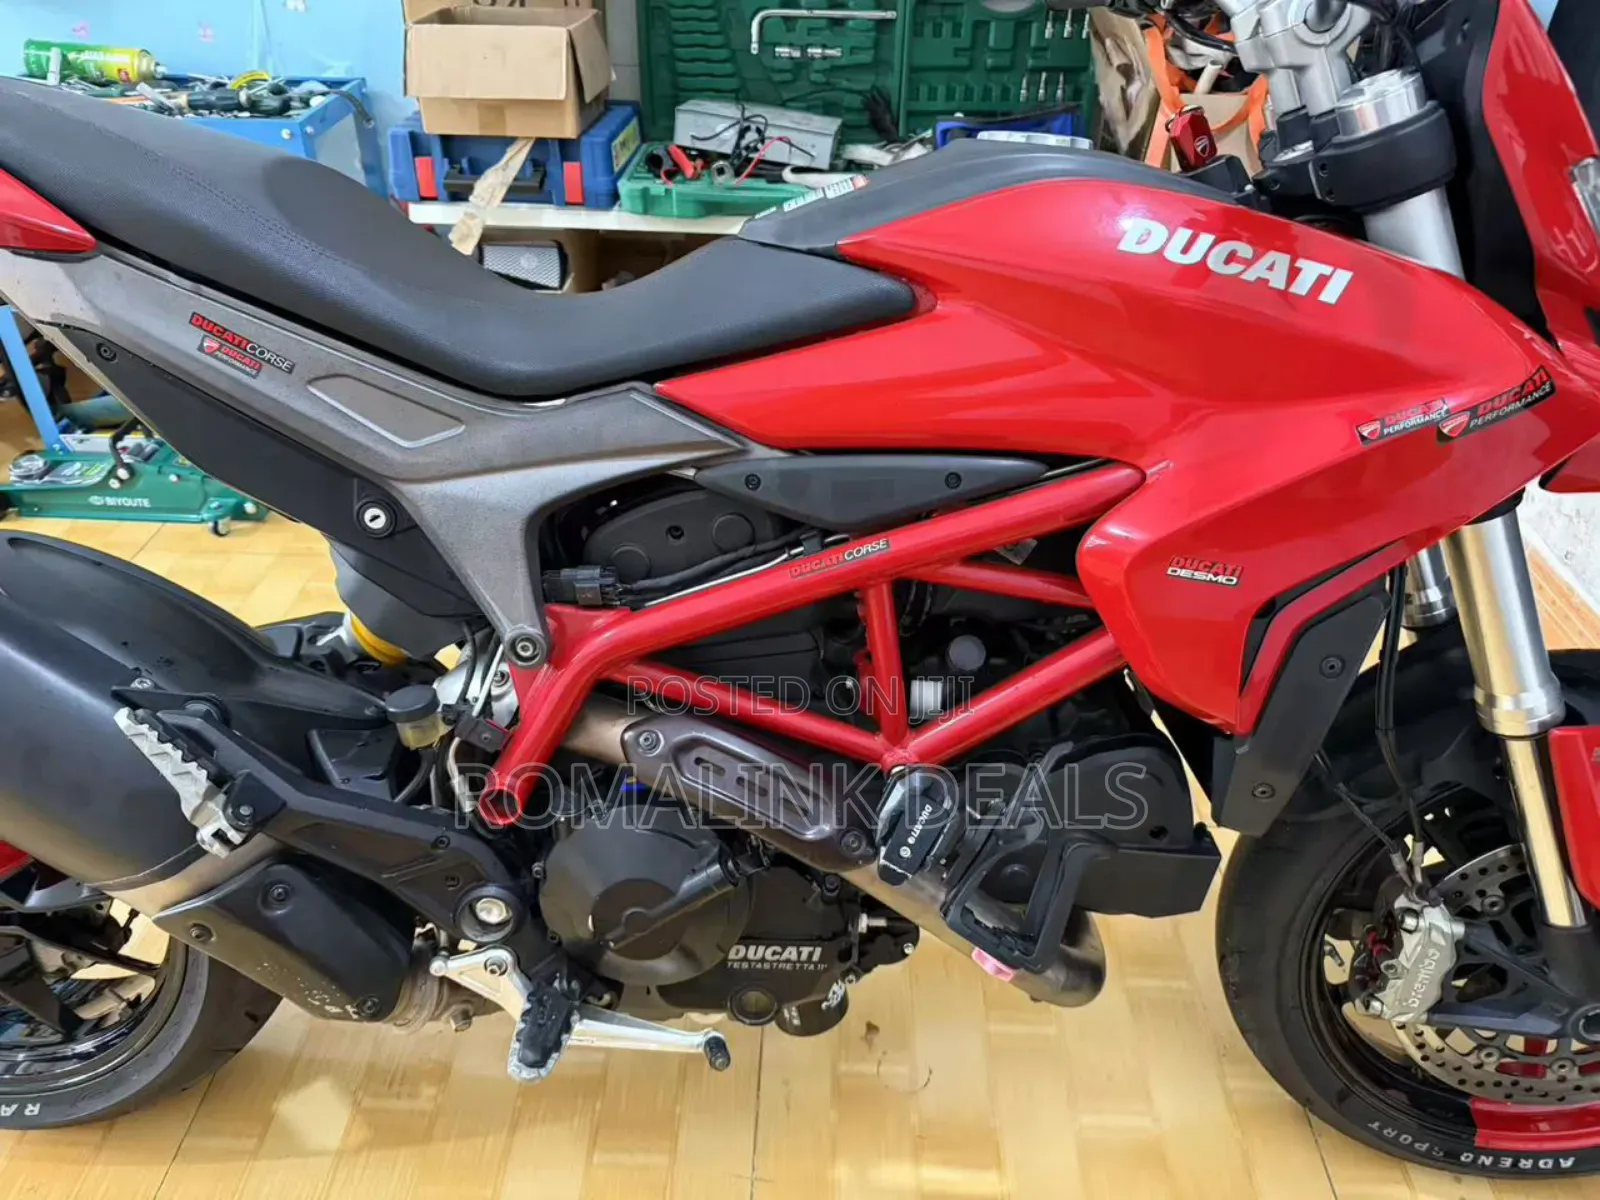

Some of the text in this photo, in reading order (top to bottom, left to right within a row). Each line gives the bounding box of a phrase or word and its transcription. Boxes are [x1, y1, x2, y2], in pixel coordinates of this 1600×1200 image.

[1117, 217, 1354, 305] DUCATI
[221, 345, 262, 371] DUCATI
[1469, 381, 1552, 429] PERFORMANCE
[1477, 370, 1550, 416] DUCATI
[1167, 567, 1239, 585] DESMO
[1170, 556, 1244, 578] DUCATI
[910, 803, 933, 839] DUCATI
[728, 944, 822, 963] DUCATI
[1408, 948, 1441, 1009] brembo
[1460, 1152, 1576, 1169] ADRENO
